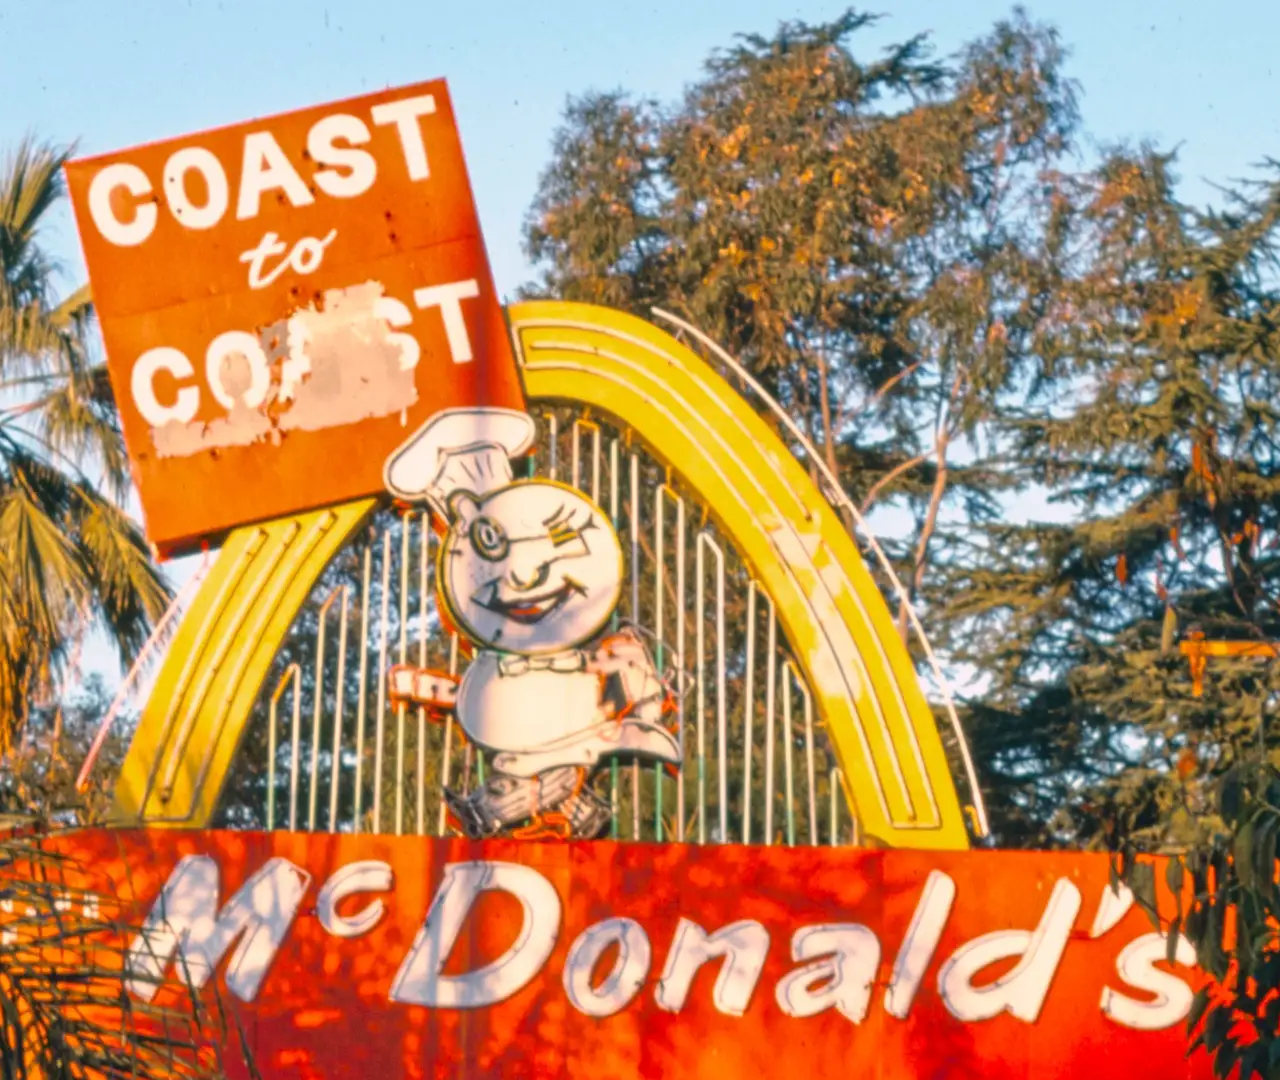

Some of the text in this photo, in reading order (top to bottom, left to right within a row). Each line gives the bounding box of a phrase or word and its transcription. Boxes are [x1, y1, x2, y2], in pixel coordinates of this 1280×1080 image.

[88, 94, 437, 247] COAST
[239, 229, 338, 290] to
[131, 279, 480, 427] COST
[122, 853, 1198, 1030] McDonald's
